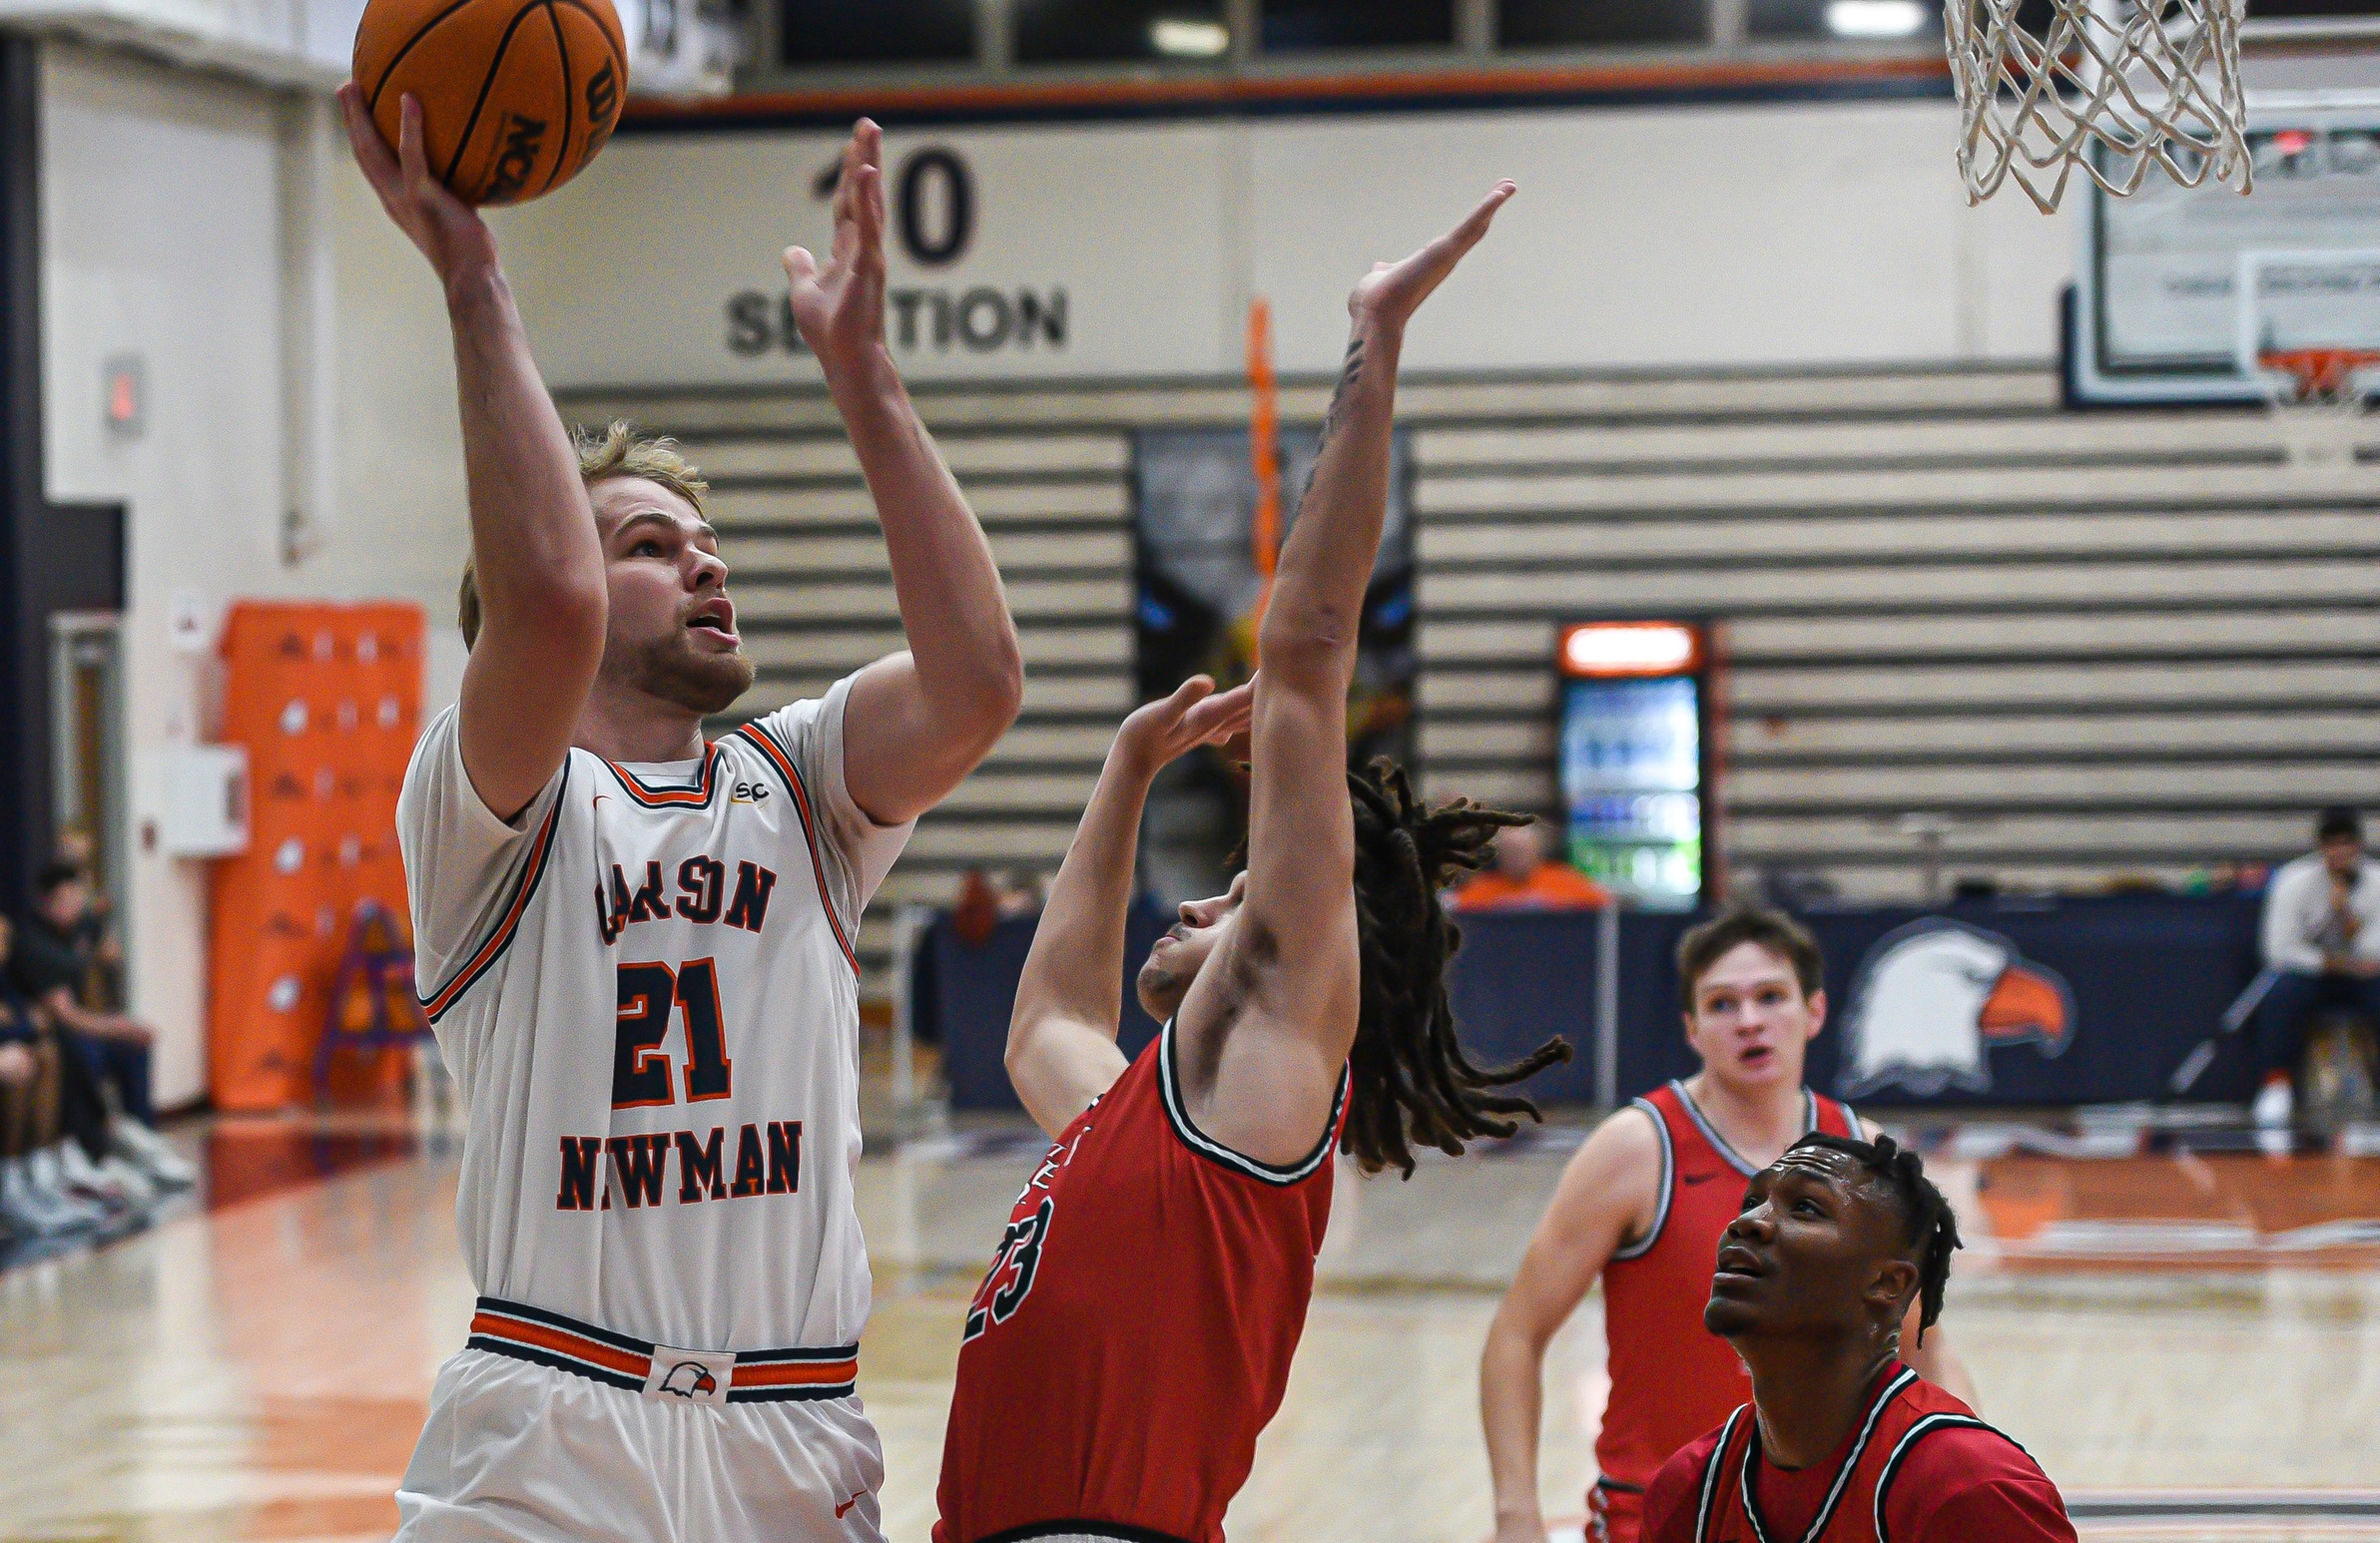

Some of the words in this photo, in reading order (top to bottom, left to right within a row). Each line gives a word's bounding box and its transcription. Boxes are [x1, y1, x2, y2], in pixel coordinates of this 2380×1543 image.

[735, 781, 770, 800] SC
[611, 956, 732, 1110] 21
[556, 1120, 803, 1211] NWMAN
